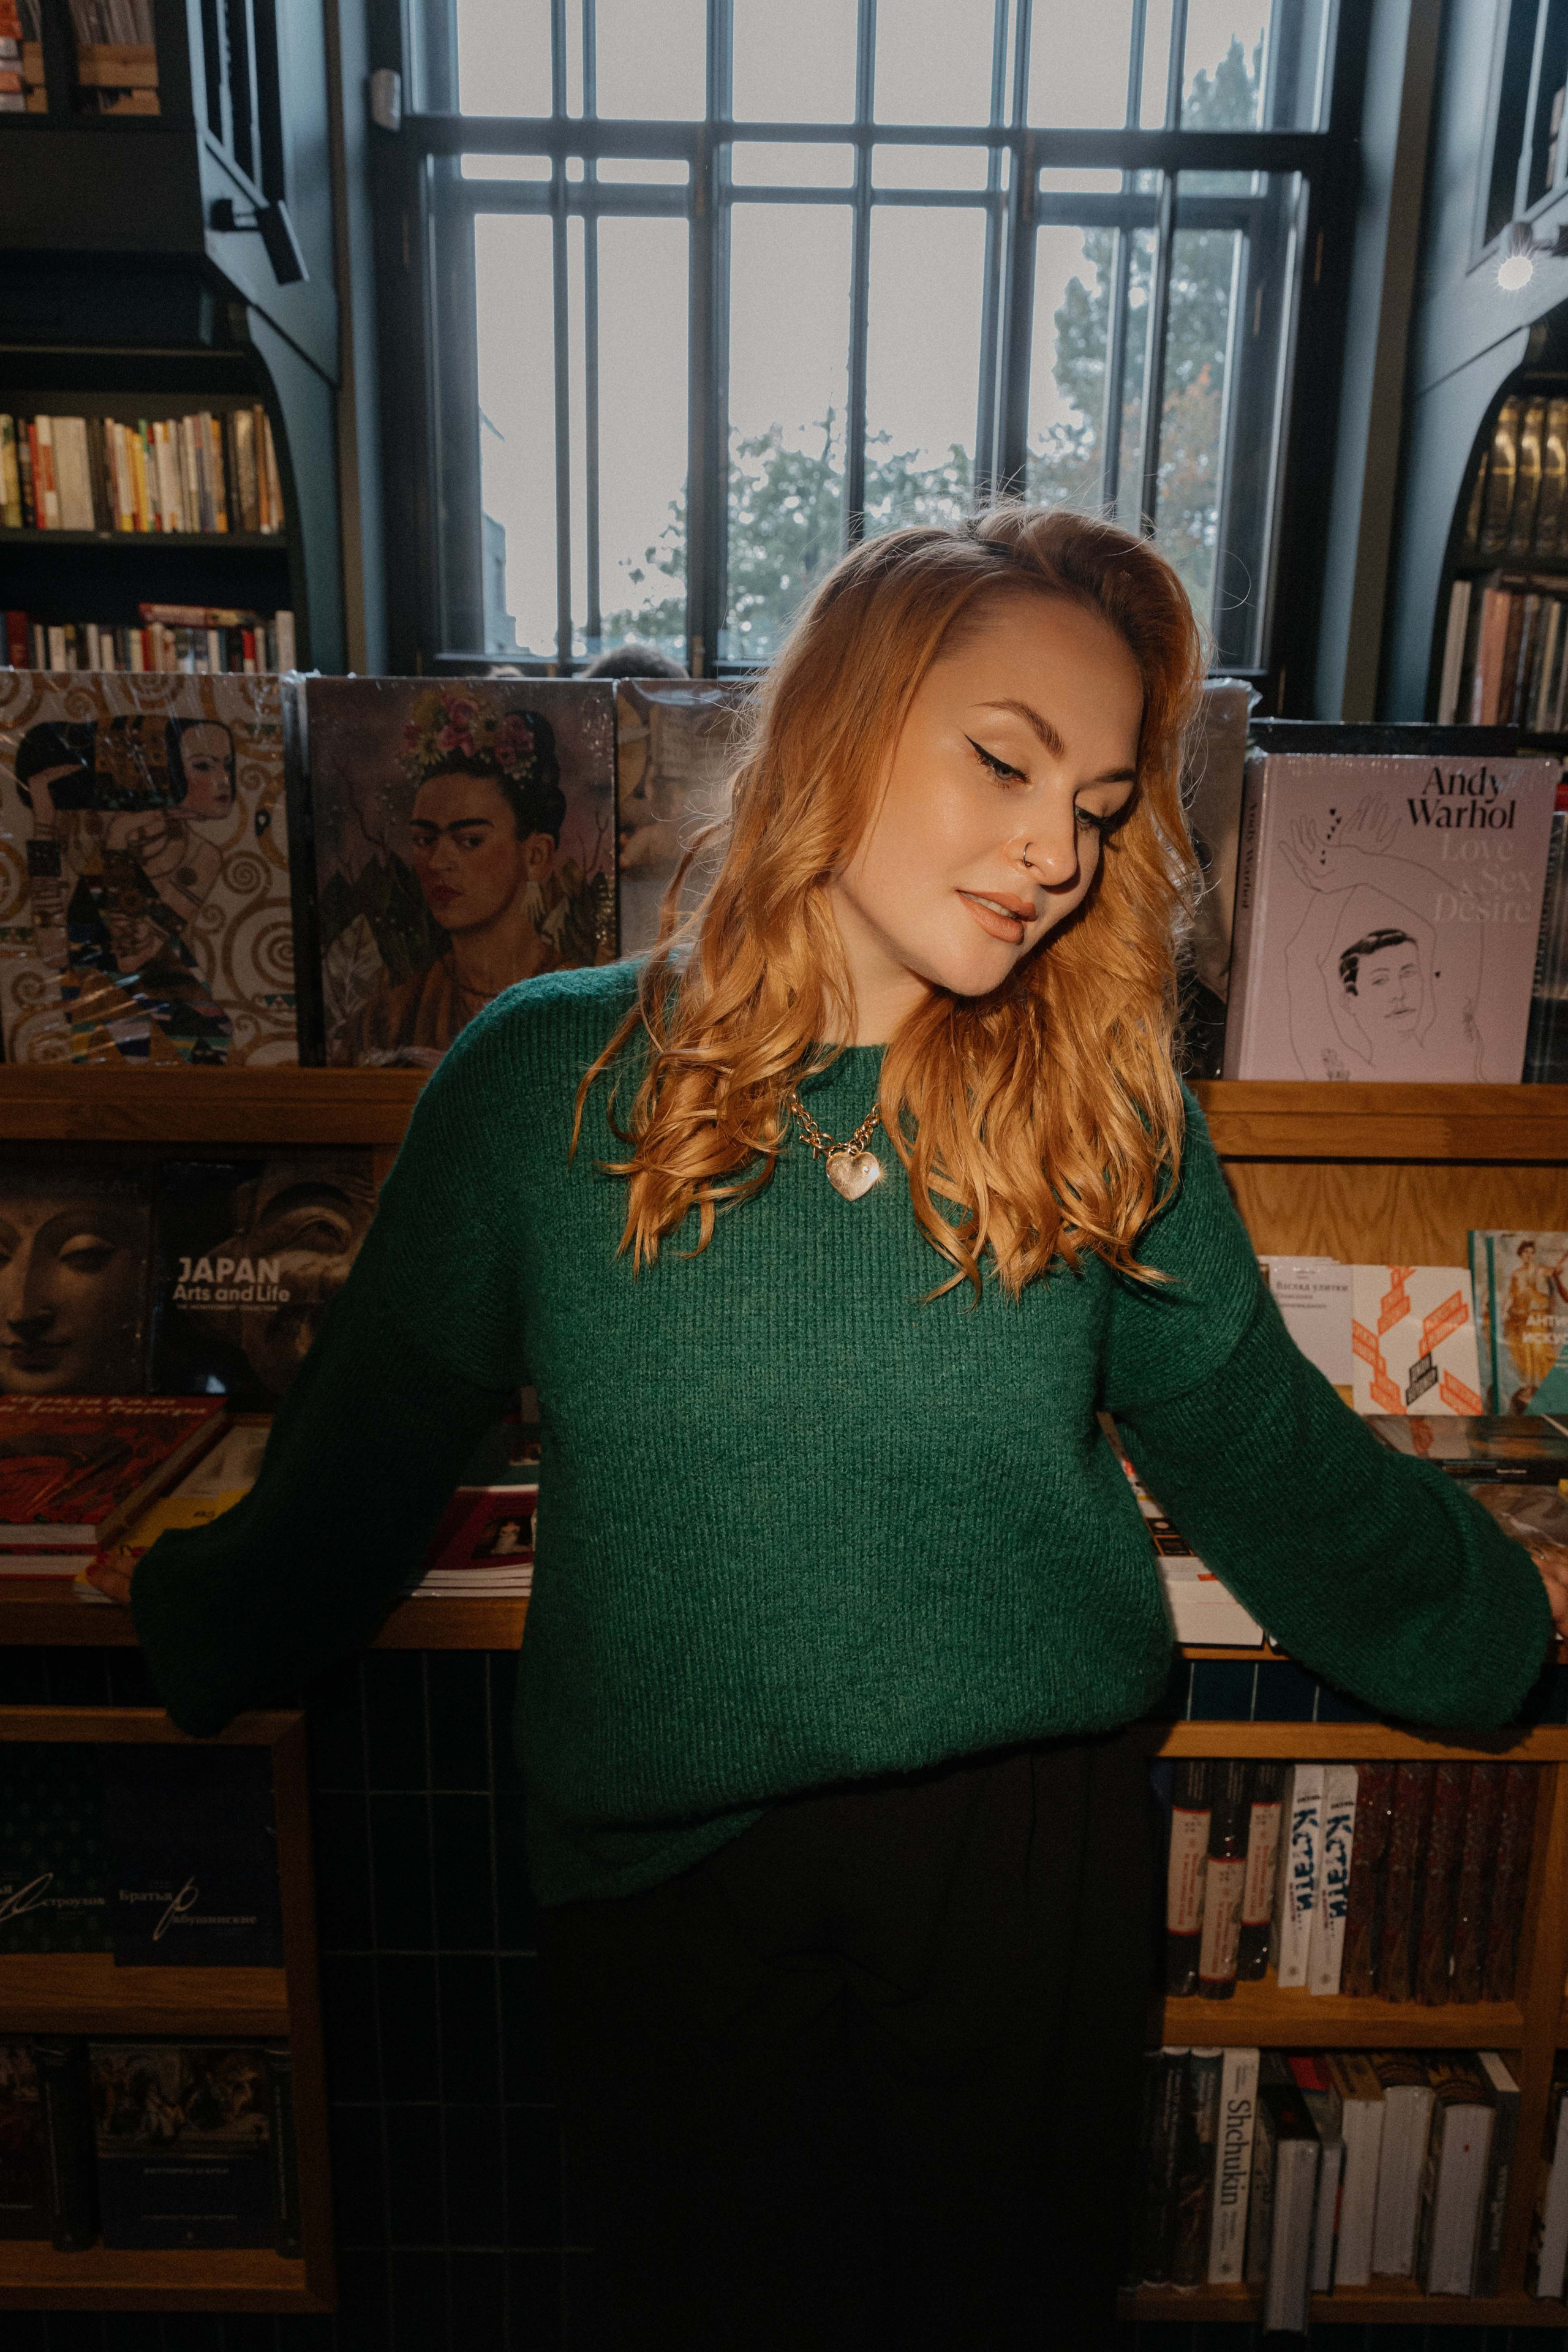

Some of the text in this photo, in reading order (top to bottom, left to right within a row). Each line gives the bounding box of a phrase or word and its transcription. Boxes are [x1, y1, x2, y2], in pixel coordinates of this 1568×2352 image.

[1422, 767, 1503, 804] Andy
[1407, 799, 1516, 829] Warhol
[1242, 802, 1258, 910] Andy Warhol
[1441, 833, 1515, 862] Love
[1480, 864, 1533, 894] Sex
[1434, 893, 1532, 923] Desire
[177, 1257, 280, 1283] JAPAN
[172, 1284, 291, 1303] Arts and Life
[1220, 2099, 1251, 2206] Shchukin
